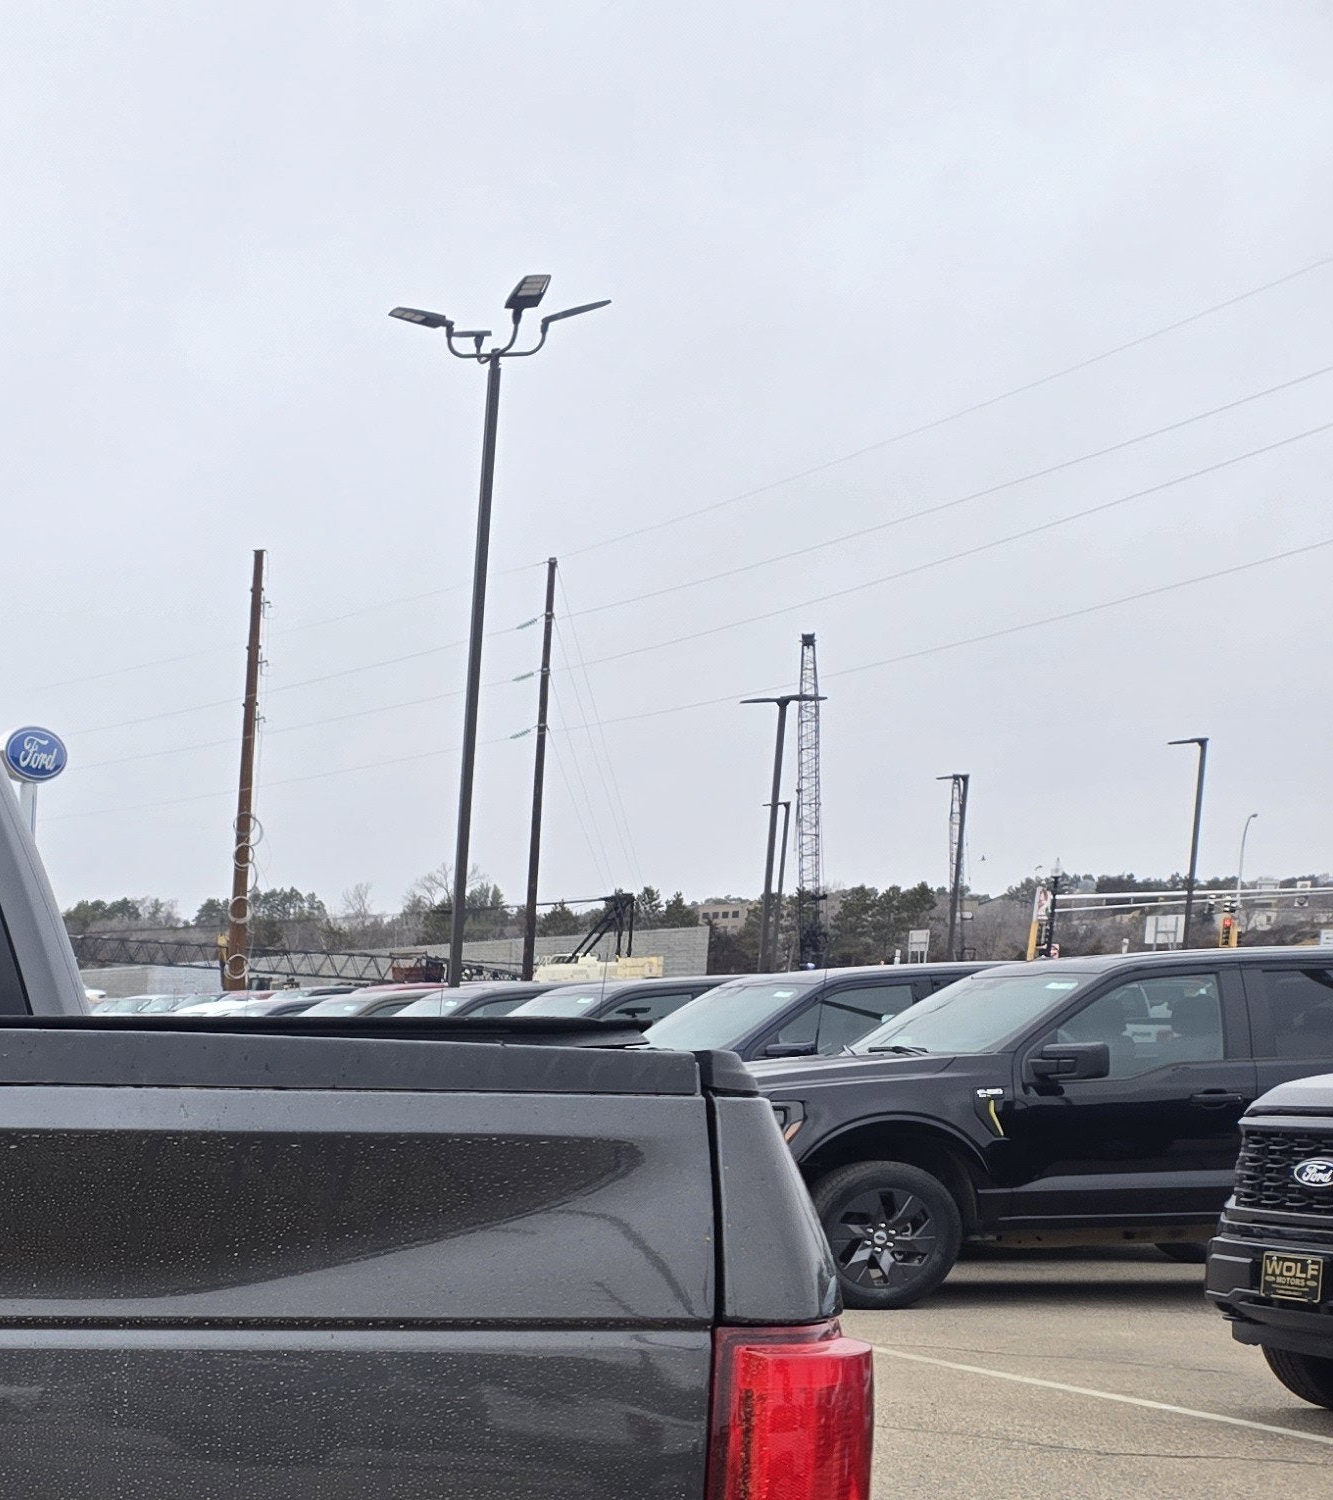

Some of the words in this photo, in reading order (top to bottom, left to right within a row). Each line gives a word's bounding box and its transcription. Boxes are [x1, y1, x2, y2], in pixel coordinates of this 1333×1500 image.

[19, 736, 58, 771] Ford
[1301, 1164, 1333, 1184] Ford
[1266, 1259, 1319, 1279] WOLF
[1276, 1276, 1305, 1287] MOTORS
